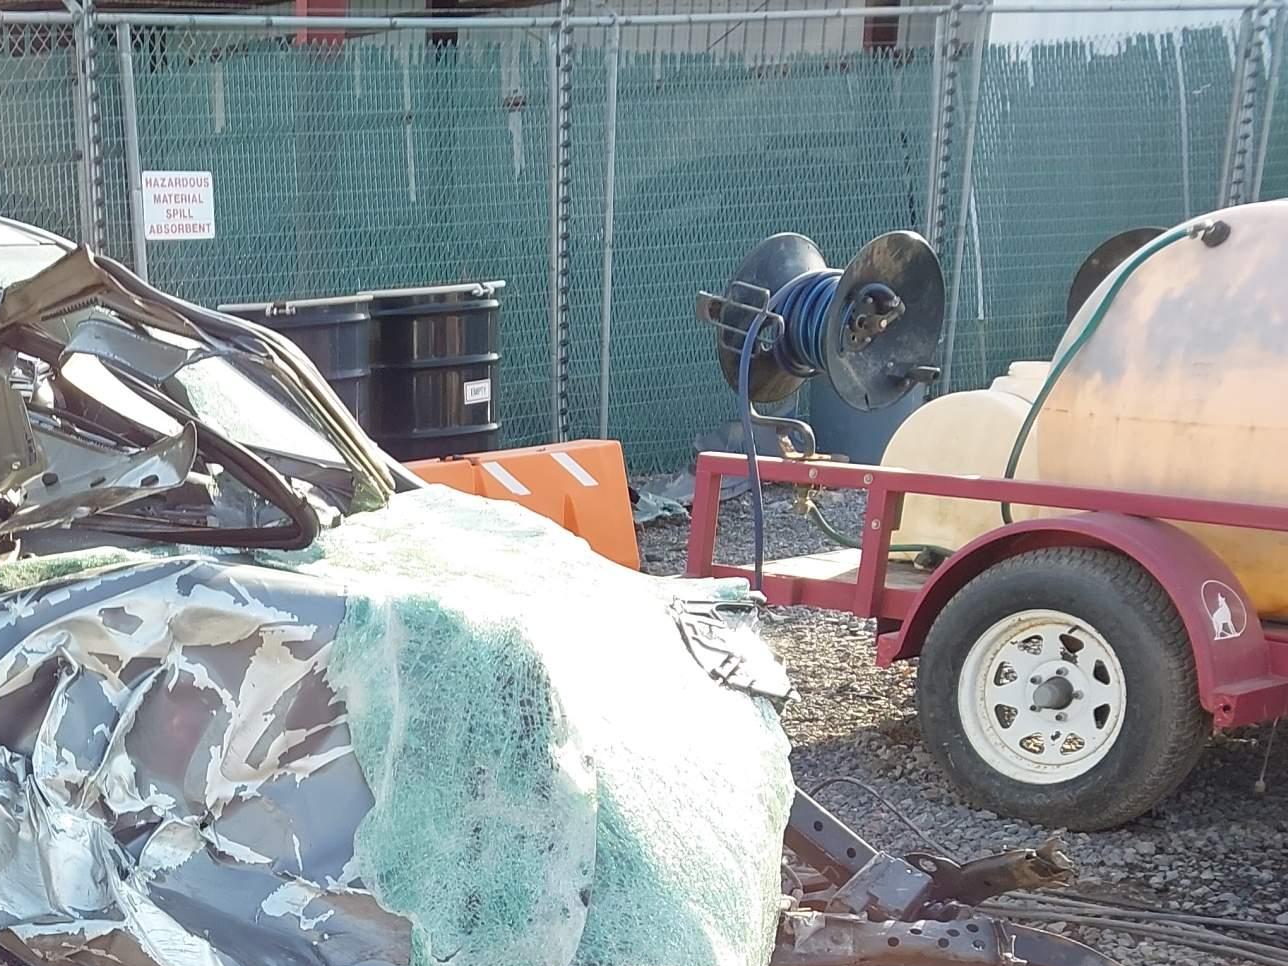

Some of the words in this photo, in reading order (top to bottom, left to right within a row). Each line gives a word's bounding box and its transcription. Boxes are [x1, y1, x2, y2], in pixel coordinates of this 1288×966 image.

[145, 177, 210, 188] HAZARDOUS
[153, 193, 204, 204] MATERIAL
[166, 208, 194, 219] SPILL
[149, 223, 212, 235] ABSORBENT
